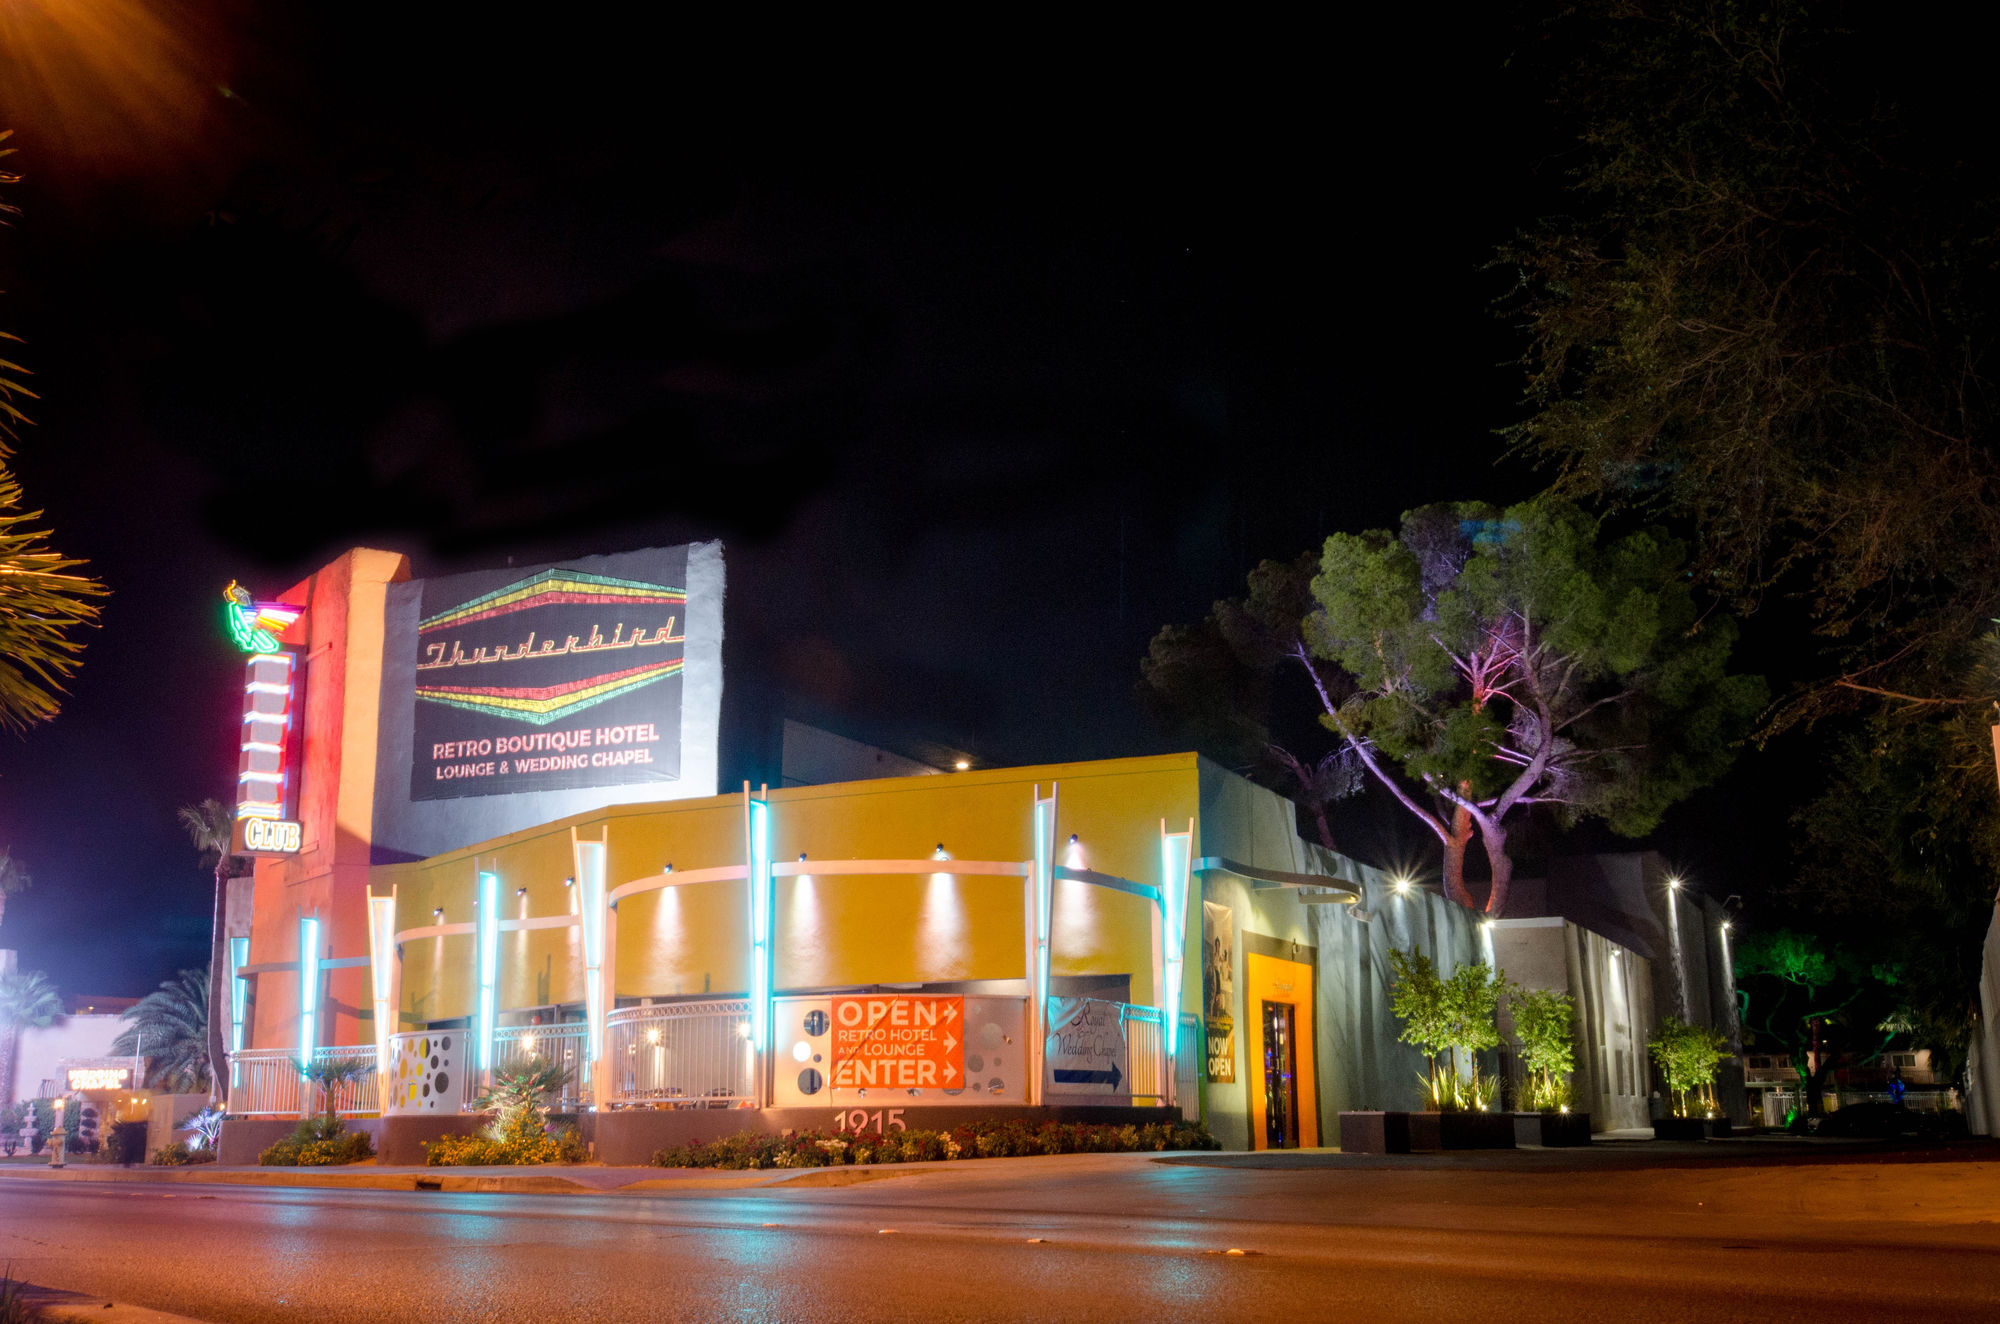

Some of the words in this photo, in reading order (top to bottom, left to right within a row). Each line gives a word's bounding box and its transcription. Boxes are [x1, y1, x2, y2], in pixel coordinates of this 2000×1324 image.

[416, 616, 685, 669] Thunderbird
[432, 739, 492, 760] RETRO
[495, 729, 592, 755] BOUTIQUE
[595, 723, 660, 746] HOTEL
[436, 761, 495, 780] LOUNGE
[499, 760, 509, 774] &
[514, 752, 588, 773] WEDDING
[591, 748, 653, 767] CHAPEL
[246, 818, 300, 851] CLUB
[838, 1000, 936, 1026] OPEN
[839, 1029, 886, 1041] RETRO
[890, 1028, 937, 1041] HOTEL
[1208, 1036, 1229, 1056] NOW
[864, 1043, 925, 1056] LOUNGE
[836, 1059, 937, 1085] ENTER
[1208, 1058, 1231, 1076] OPEN
[834, 1109, 906, 1137] 1915
